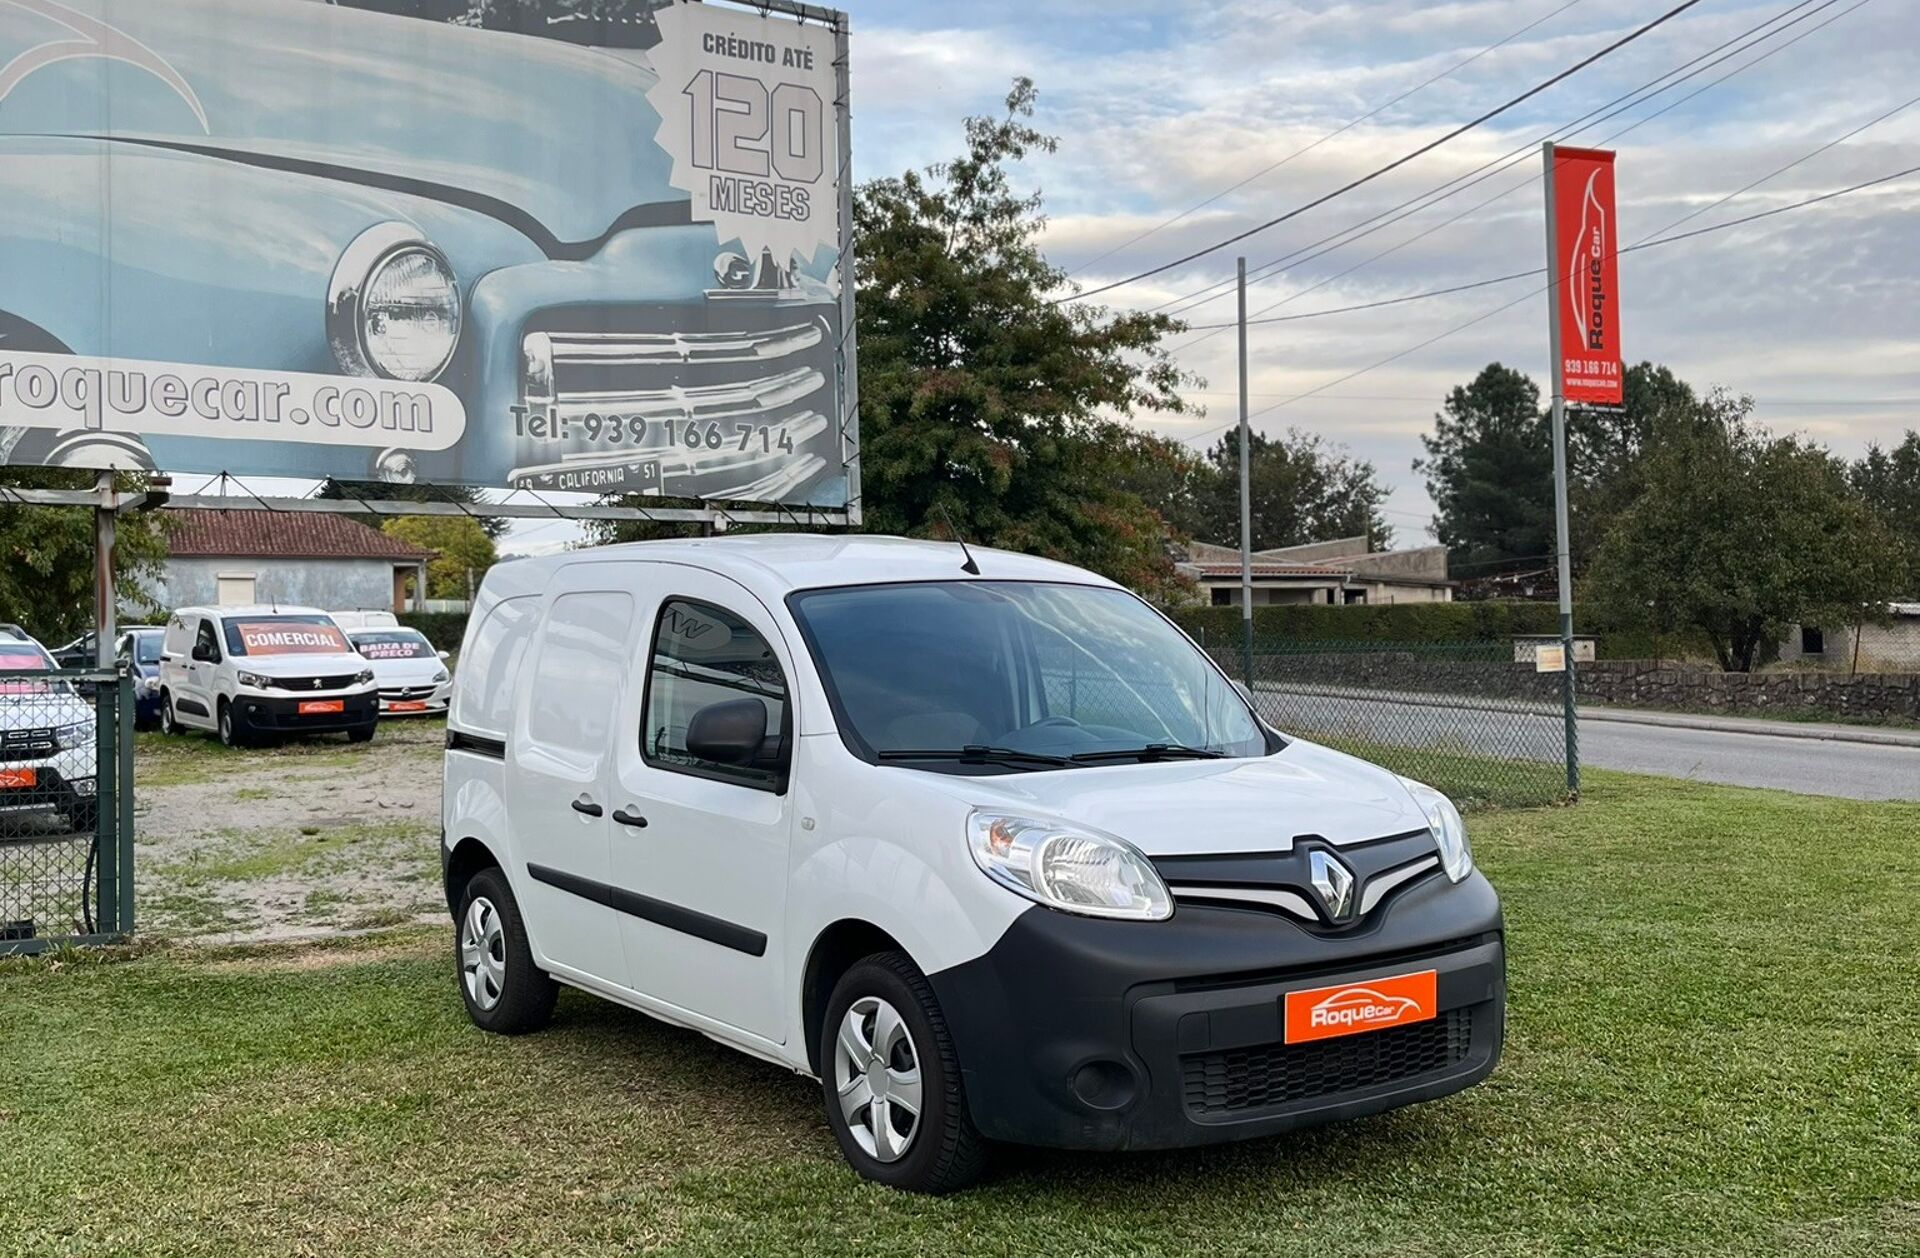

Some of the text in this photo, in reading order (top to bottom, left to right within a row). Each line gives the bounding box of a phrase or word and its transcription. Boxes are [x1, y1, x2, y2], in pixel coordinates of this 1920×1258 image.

[702, 32, 813, 71] CRÉDITO ATÉ
[682, 68, 823, 184] 120
[709, 174, 810, 222] MESES
[1565, 359, 1582, 374] 939
[1601, 361, 1617, 376] 714
[509, 405, 795, 455] Tel: 939 166 714
[558, 467, 625, 490] CALIFORNIA
[644, 463, 656, 479] 51
[245, 631, 341, 648] COMERCIAL
[360, 642, 420, 653] BAIXA DE
